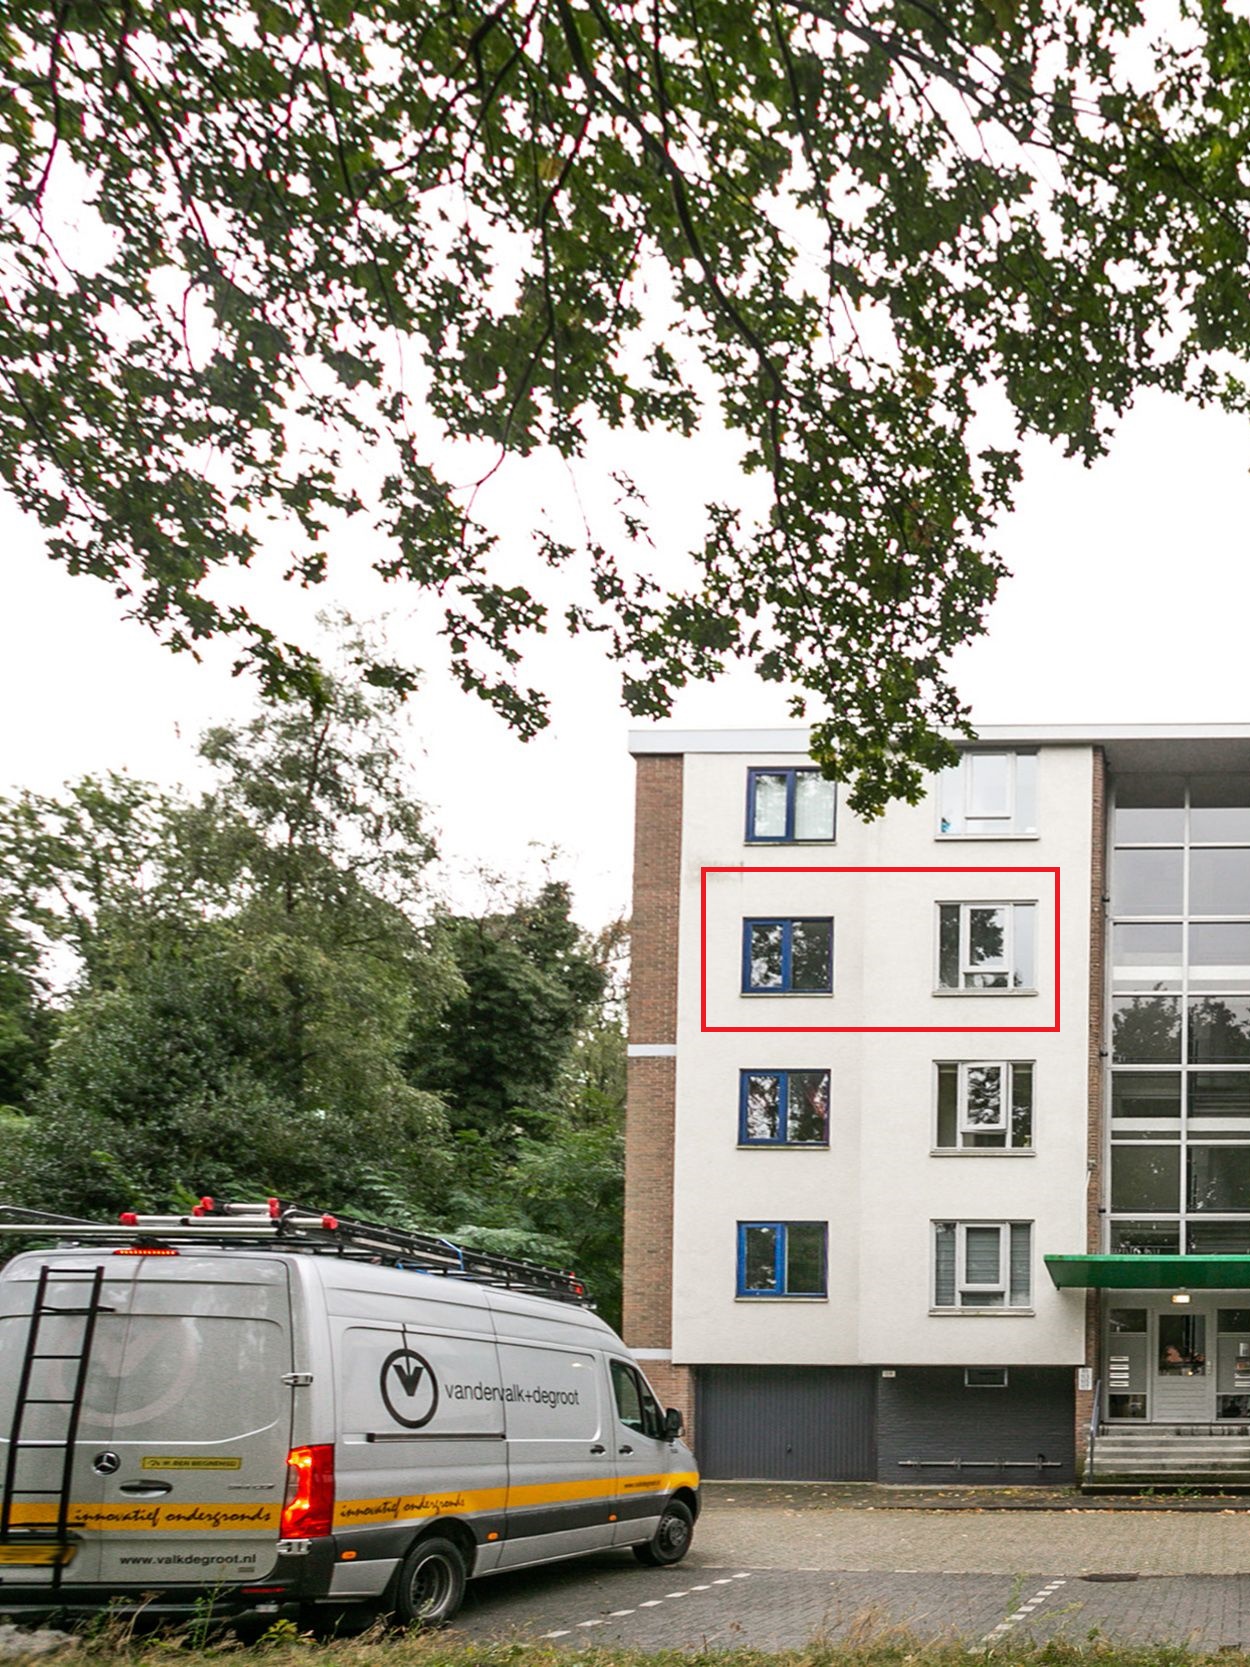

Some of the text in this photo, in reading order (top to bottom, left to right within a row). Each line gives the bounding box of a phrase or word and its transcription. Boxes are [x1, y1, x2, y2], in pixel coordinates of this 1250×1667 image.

[444, 1381, 580, 1408] vandervalk+degroot
[75, 1506, 271, 1527] innovatief ondergronds
[340, 1493, 465, 1519] innovatief ondergronds
[120, 1553, 257, 1566] www.valkdegroot.nl
